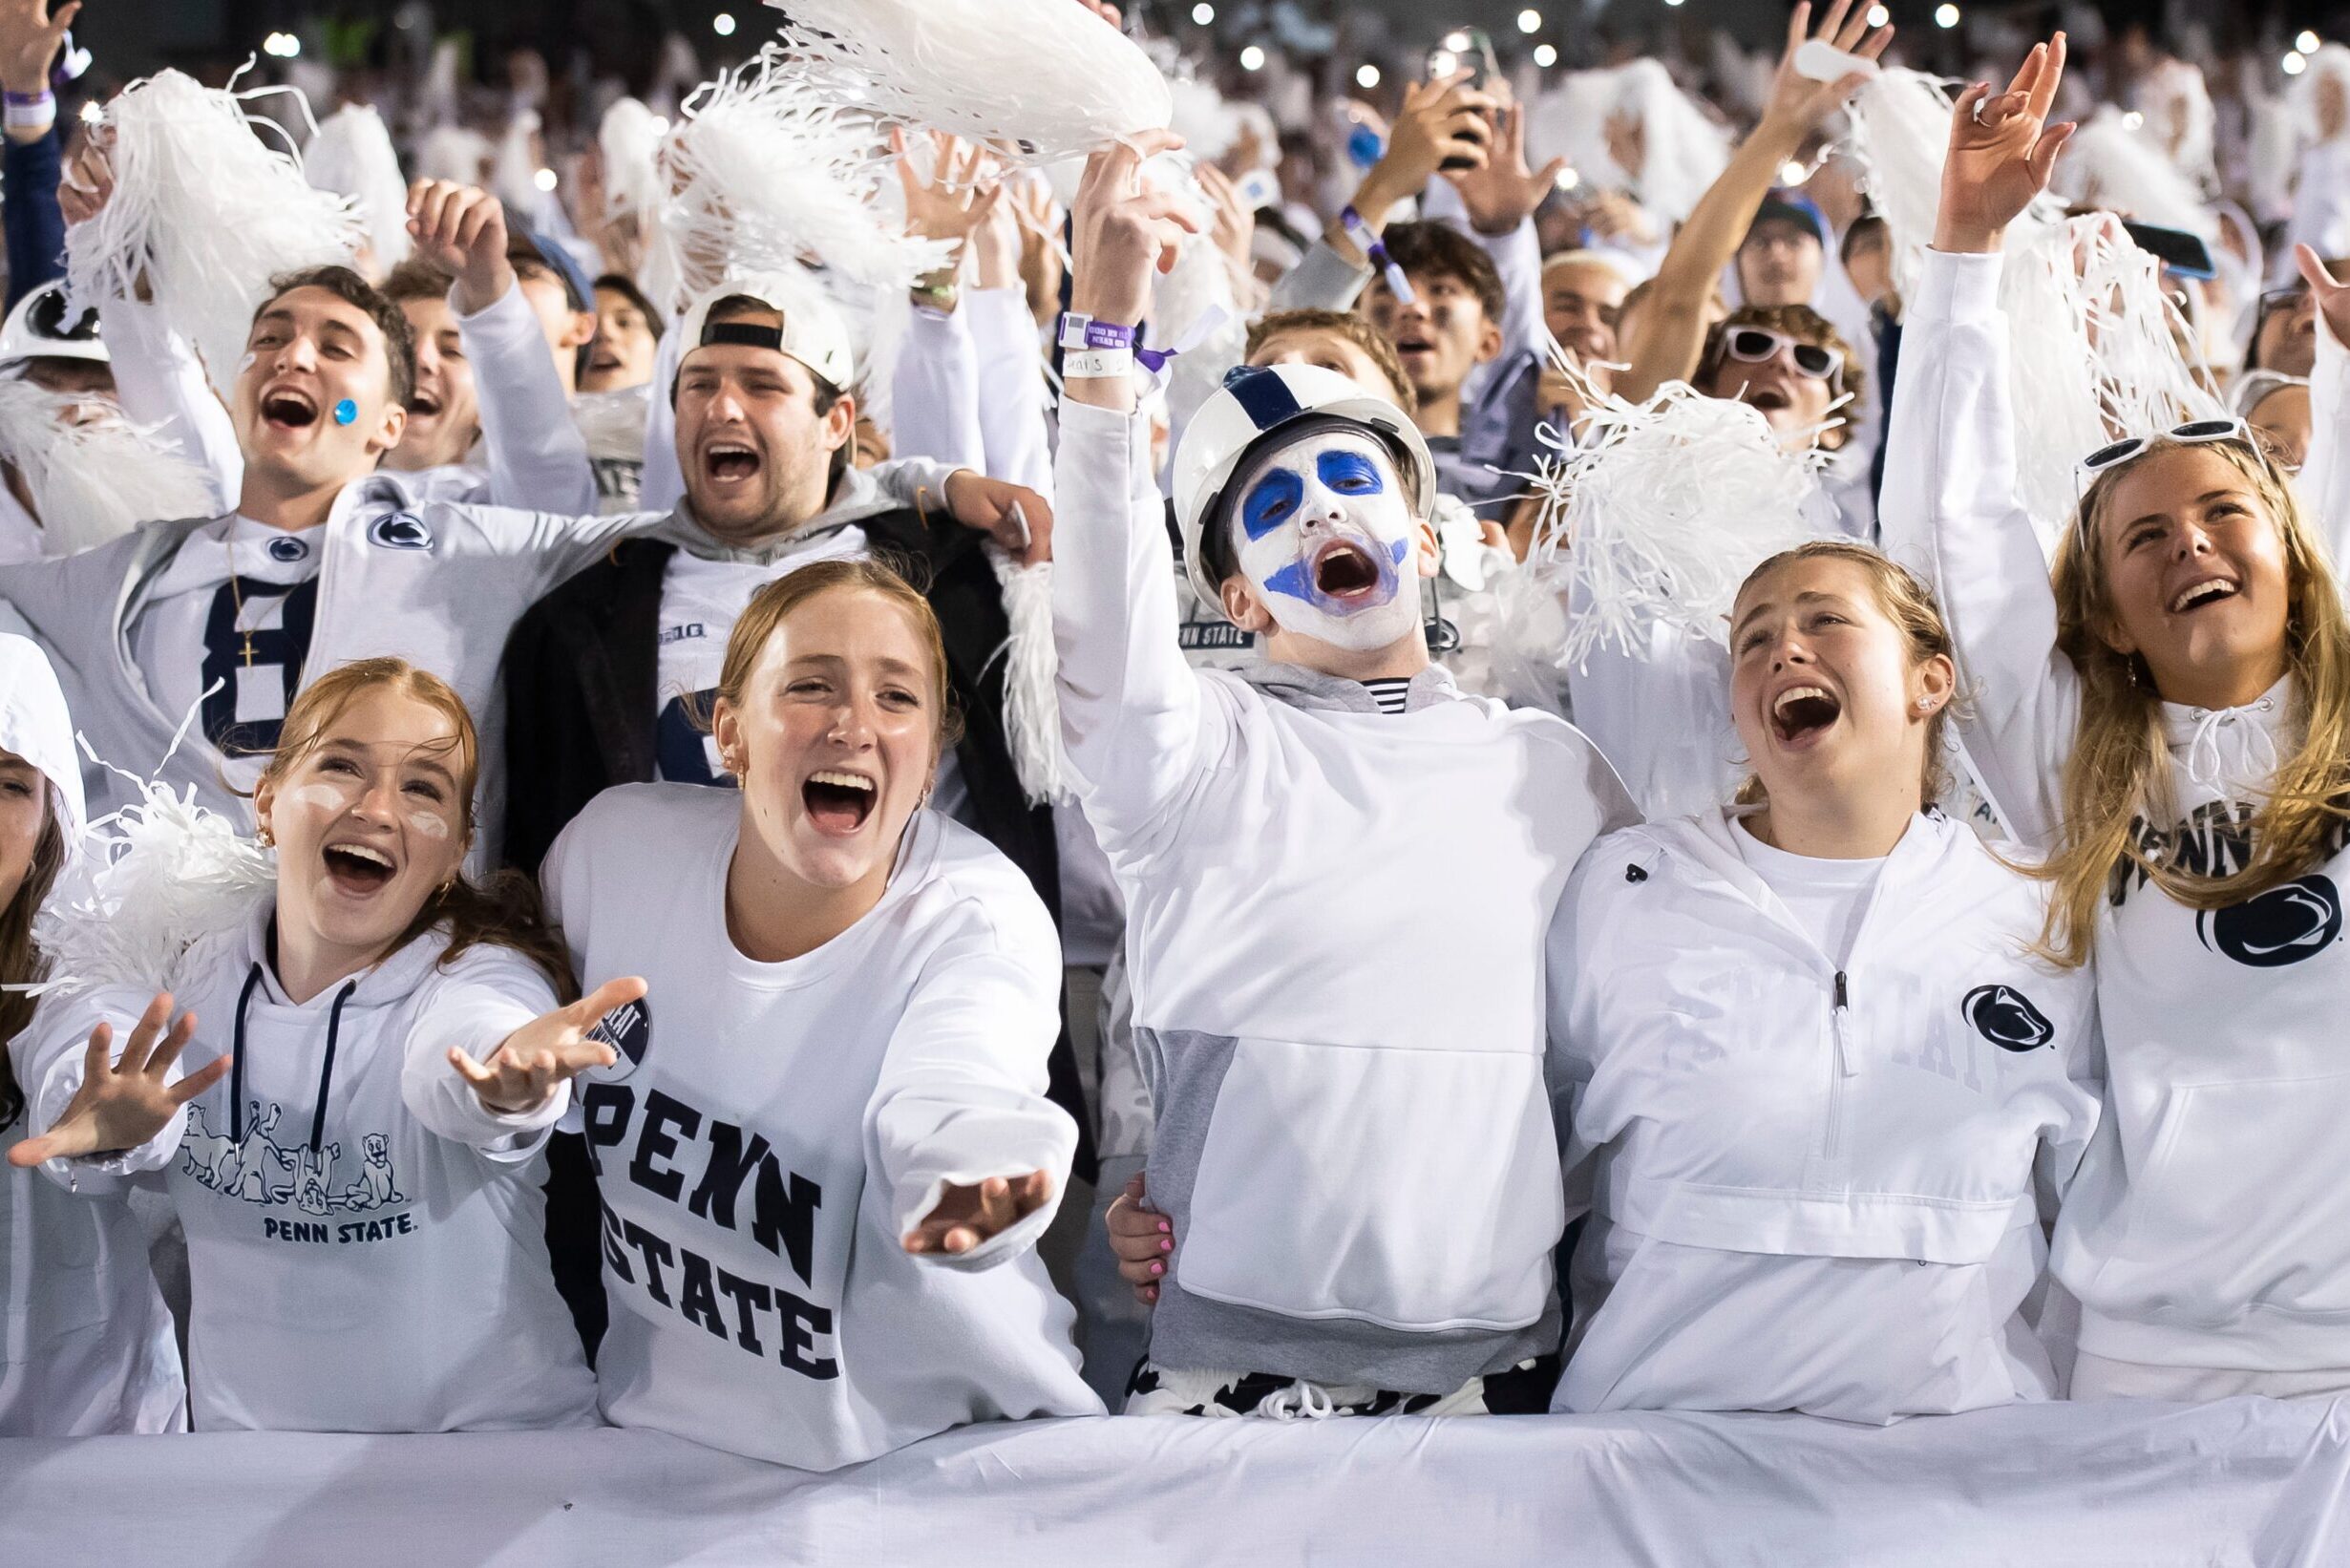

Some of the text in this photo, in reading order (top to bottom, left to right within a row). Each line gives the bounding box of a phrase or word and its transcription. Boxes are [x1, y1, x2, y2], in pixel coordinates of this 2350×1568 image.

[201, 575, 319, 760] 8
[1202, 625, 1244, 645] STATE
[264, 1218, 329, 1243] PENN
[582, 1082, 822, 1291] PENN
[601, 1194, 840, 1381] STATE
